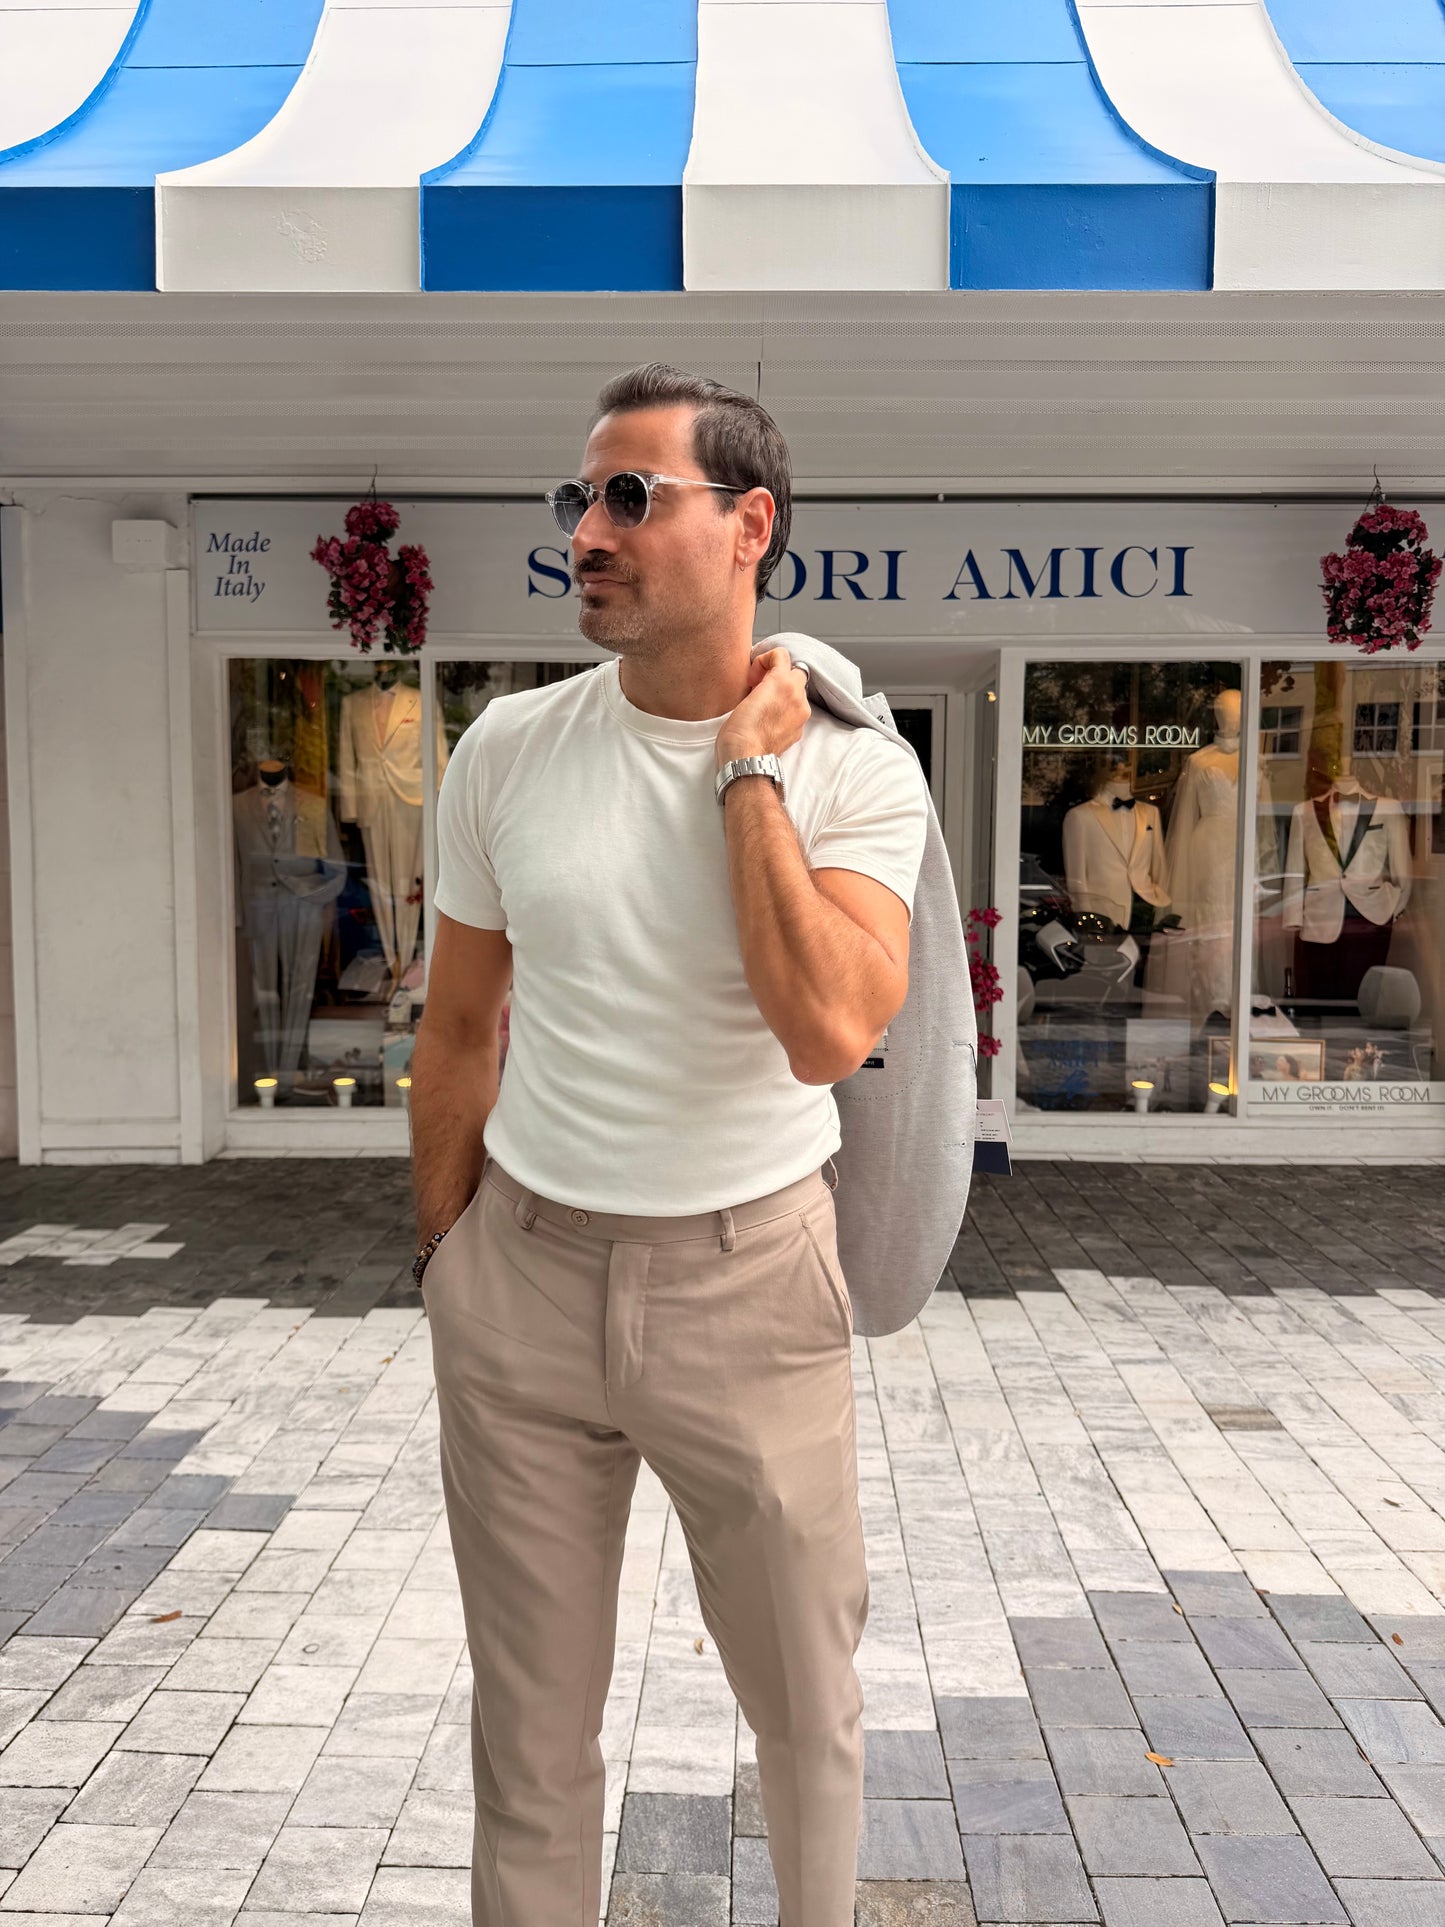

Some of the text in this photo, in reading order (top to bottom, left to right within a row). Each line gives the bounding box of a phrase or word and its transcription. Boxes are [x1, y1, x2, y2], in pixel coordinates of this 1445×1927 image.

[206, 531, 271, 553] Made
[227, 554, 250, 575] In
[528, 546, 1195, 600] SORI AMICI
[214, 575, 266, 603] Italy
[1022, 724, 1199, 745] MY GROOMS ROOM
[1262, 1086, 1430, 1101] MY GROOMS ROOM
